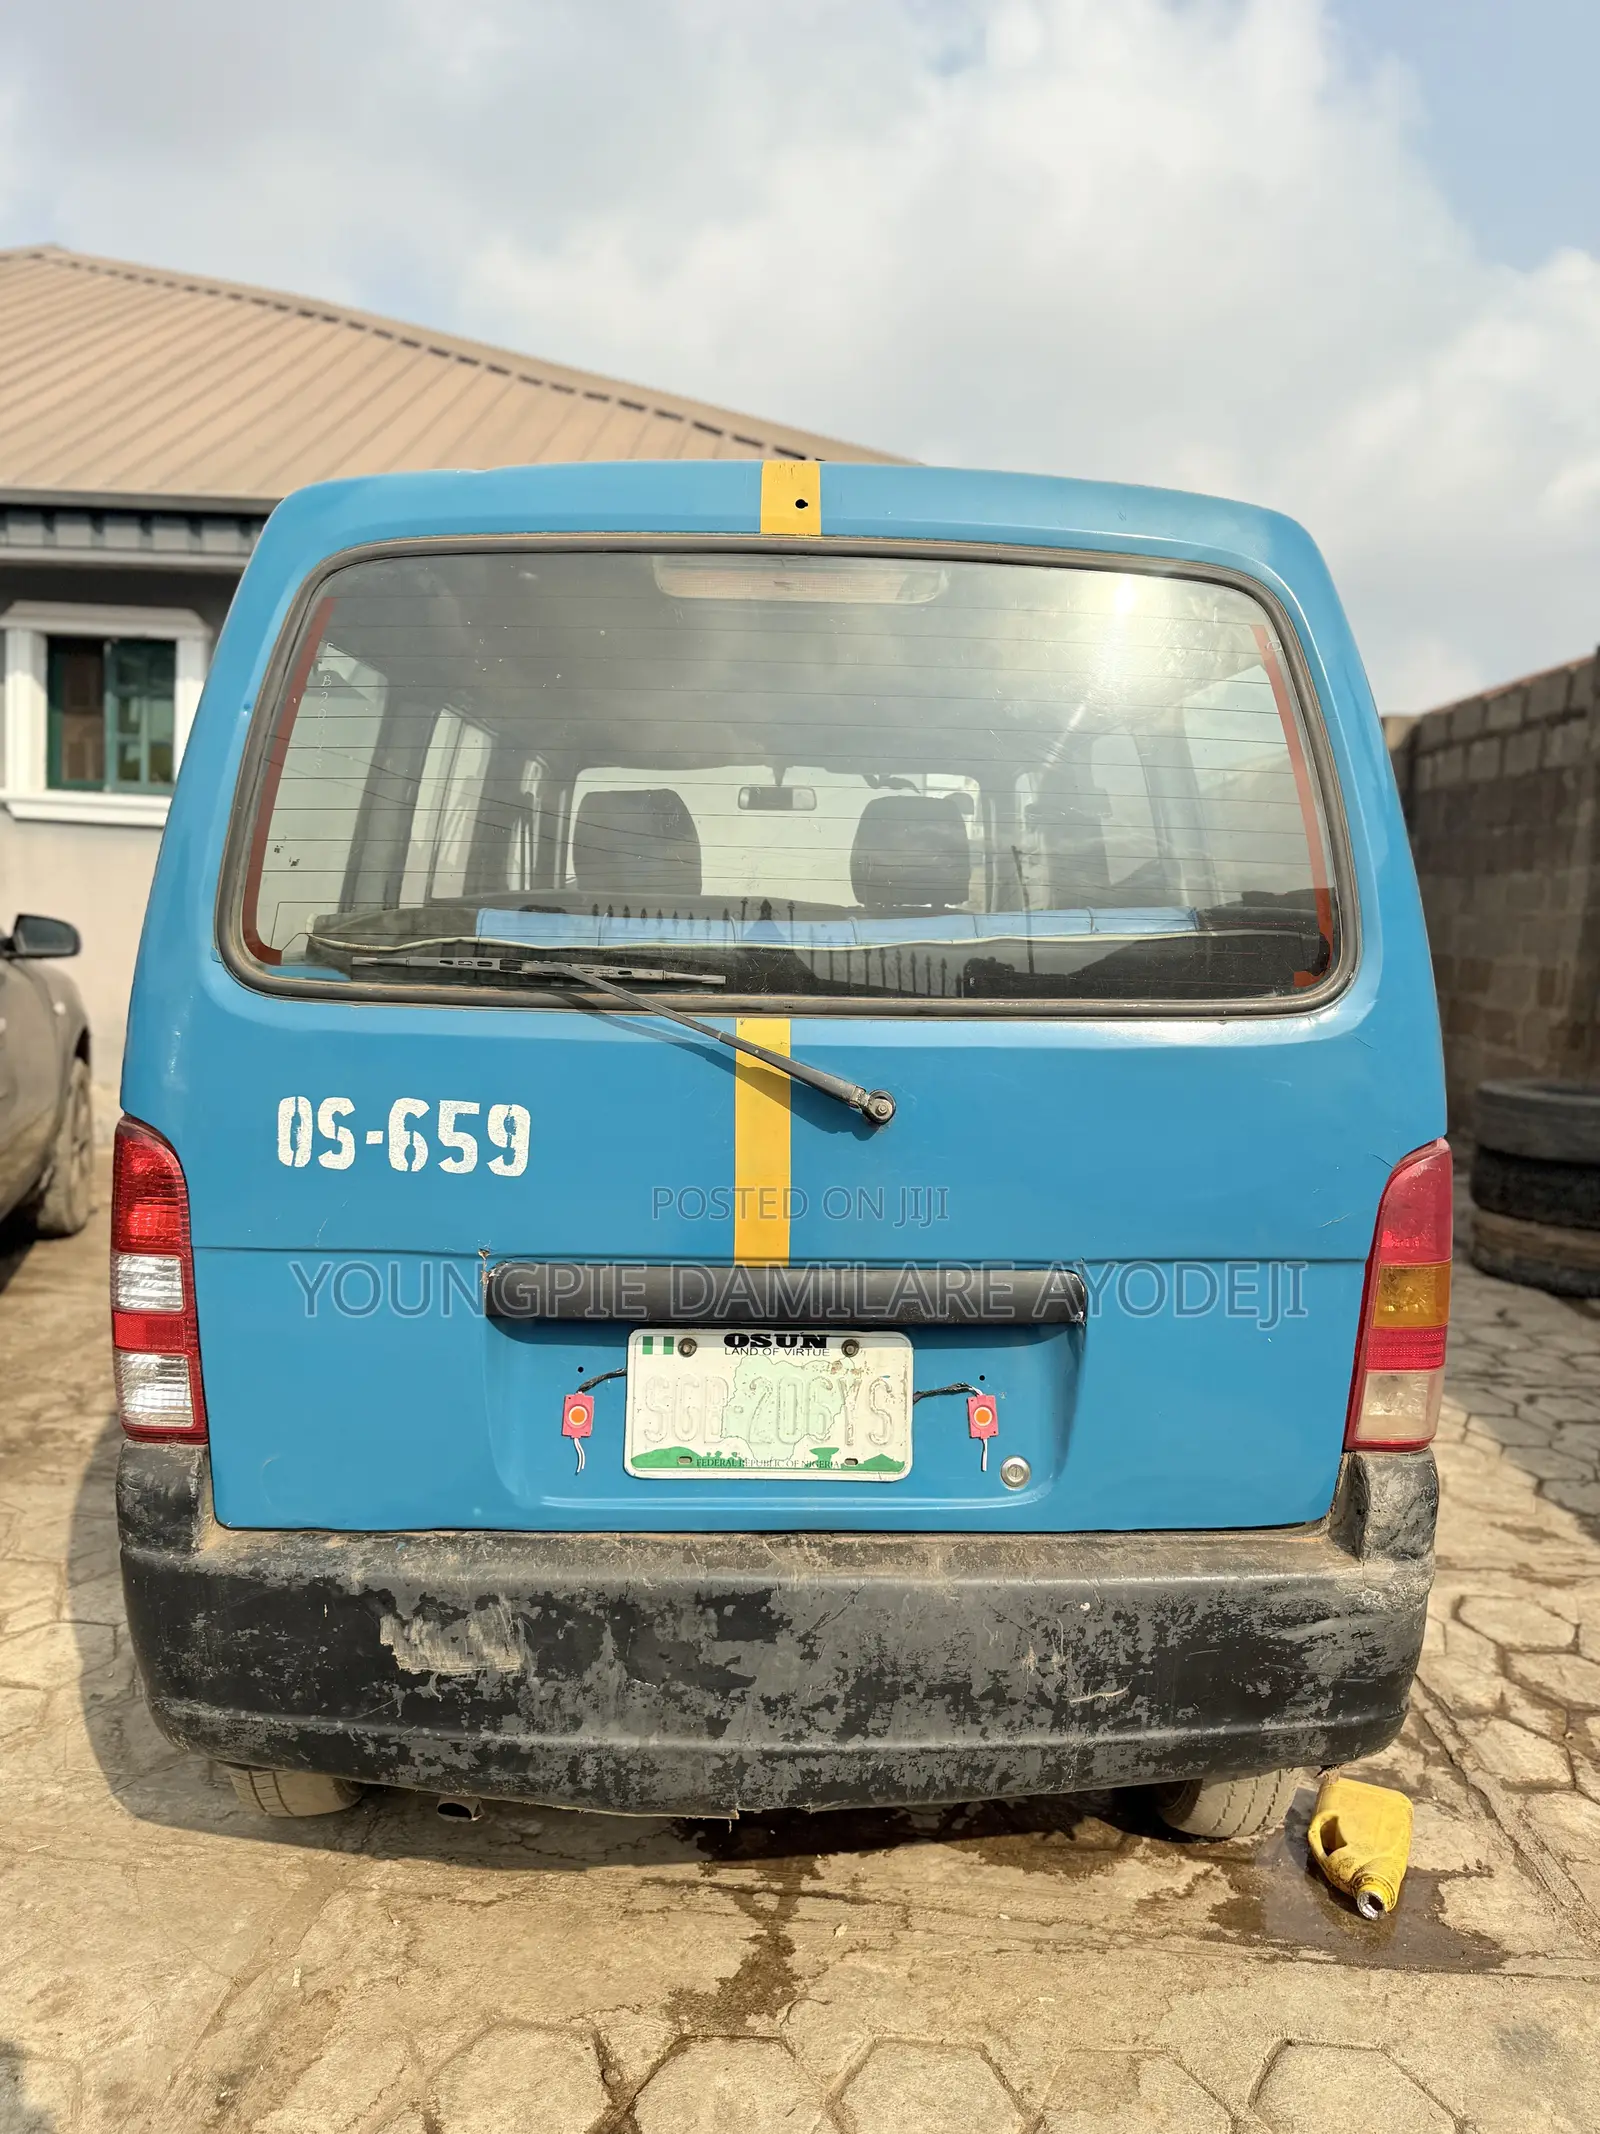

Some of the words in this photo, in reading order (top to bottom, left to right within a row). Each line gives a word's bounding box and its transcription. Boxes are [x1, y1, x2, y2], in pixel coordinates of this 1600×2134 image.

[277, 1096, 531, 1177] OS-659
[723, 1333, 829, 1349] OSUN
[724, 1347, 759, 1356] LAND
[762, 1347, 780, 1356] OF
[783, 1348, 830, 1357] VIRTUE
[696, 1458, 737, 1468] FEDERAL
[739, 1458, 784, 1468] REPUBLIC
[786, 1458, 799, 1468] OF
[801, 1459, 840, 1469] NIGERIA
